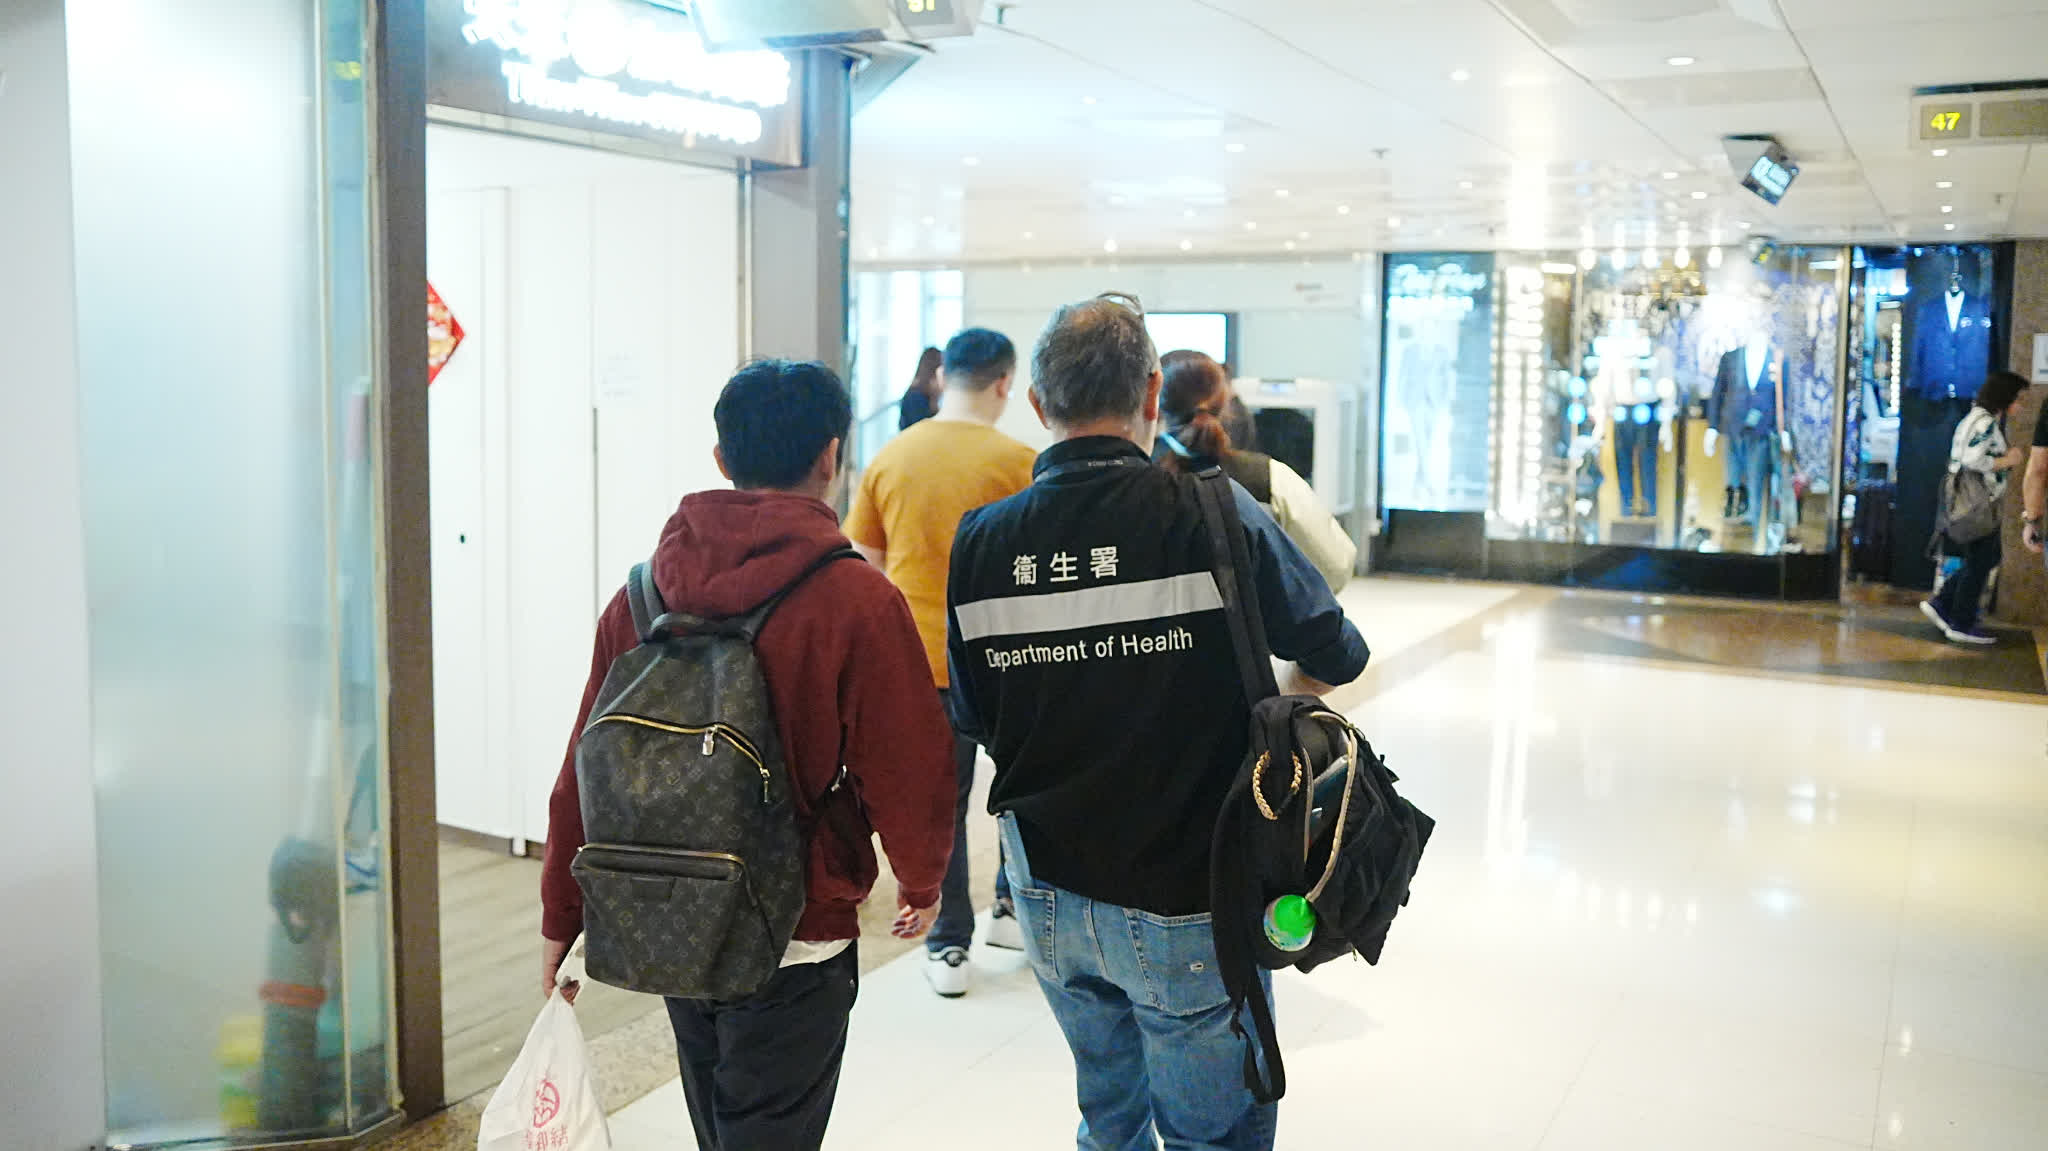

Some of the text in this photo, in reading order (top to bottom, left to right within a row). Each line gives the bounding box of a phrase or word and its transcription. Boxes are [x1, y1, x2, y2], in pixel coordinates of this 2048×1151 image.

[1931, 112, 1961, 131] 47
[985, 627, 1193, 672] Department of Health
